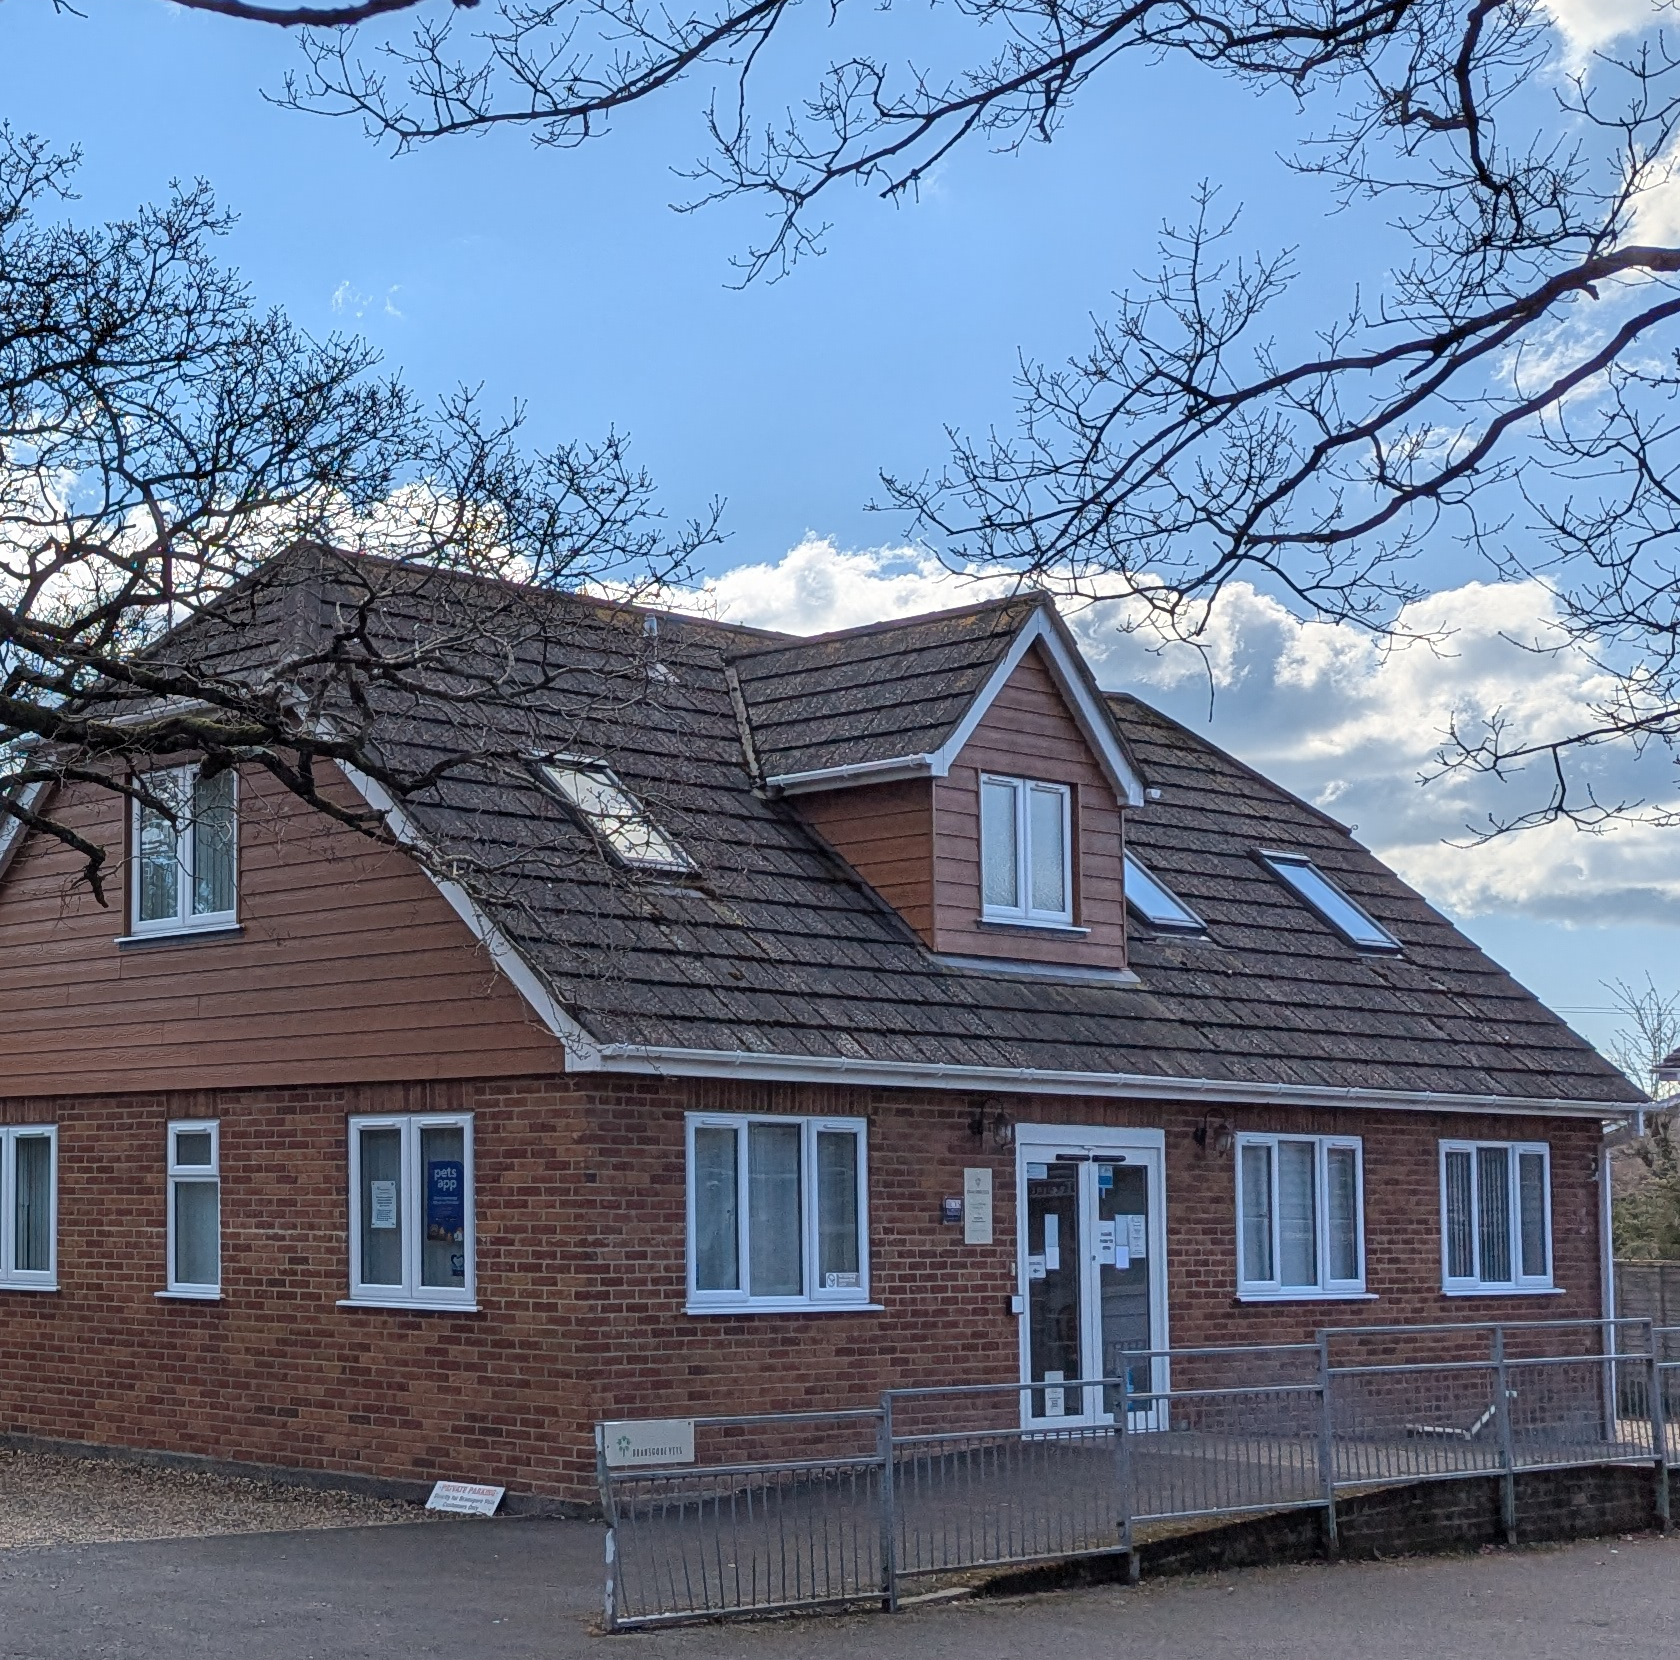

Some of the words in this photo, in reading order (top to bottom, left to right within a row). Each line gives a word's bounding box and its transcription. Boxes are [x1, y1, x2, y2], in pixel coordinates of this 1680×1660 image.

[434, 1167, 457, 1182] pets
[437, 1179, 457, 1191] app
[441, 1484, 467, 1493] PRIVATE
[468, 1486, 497, 1496] PARKING
